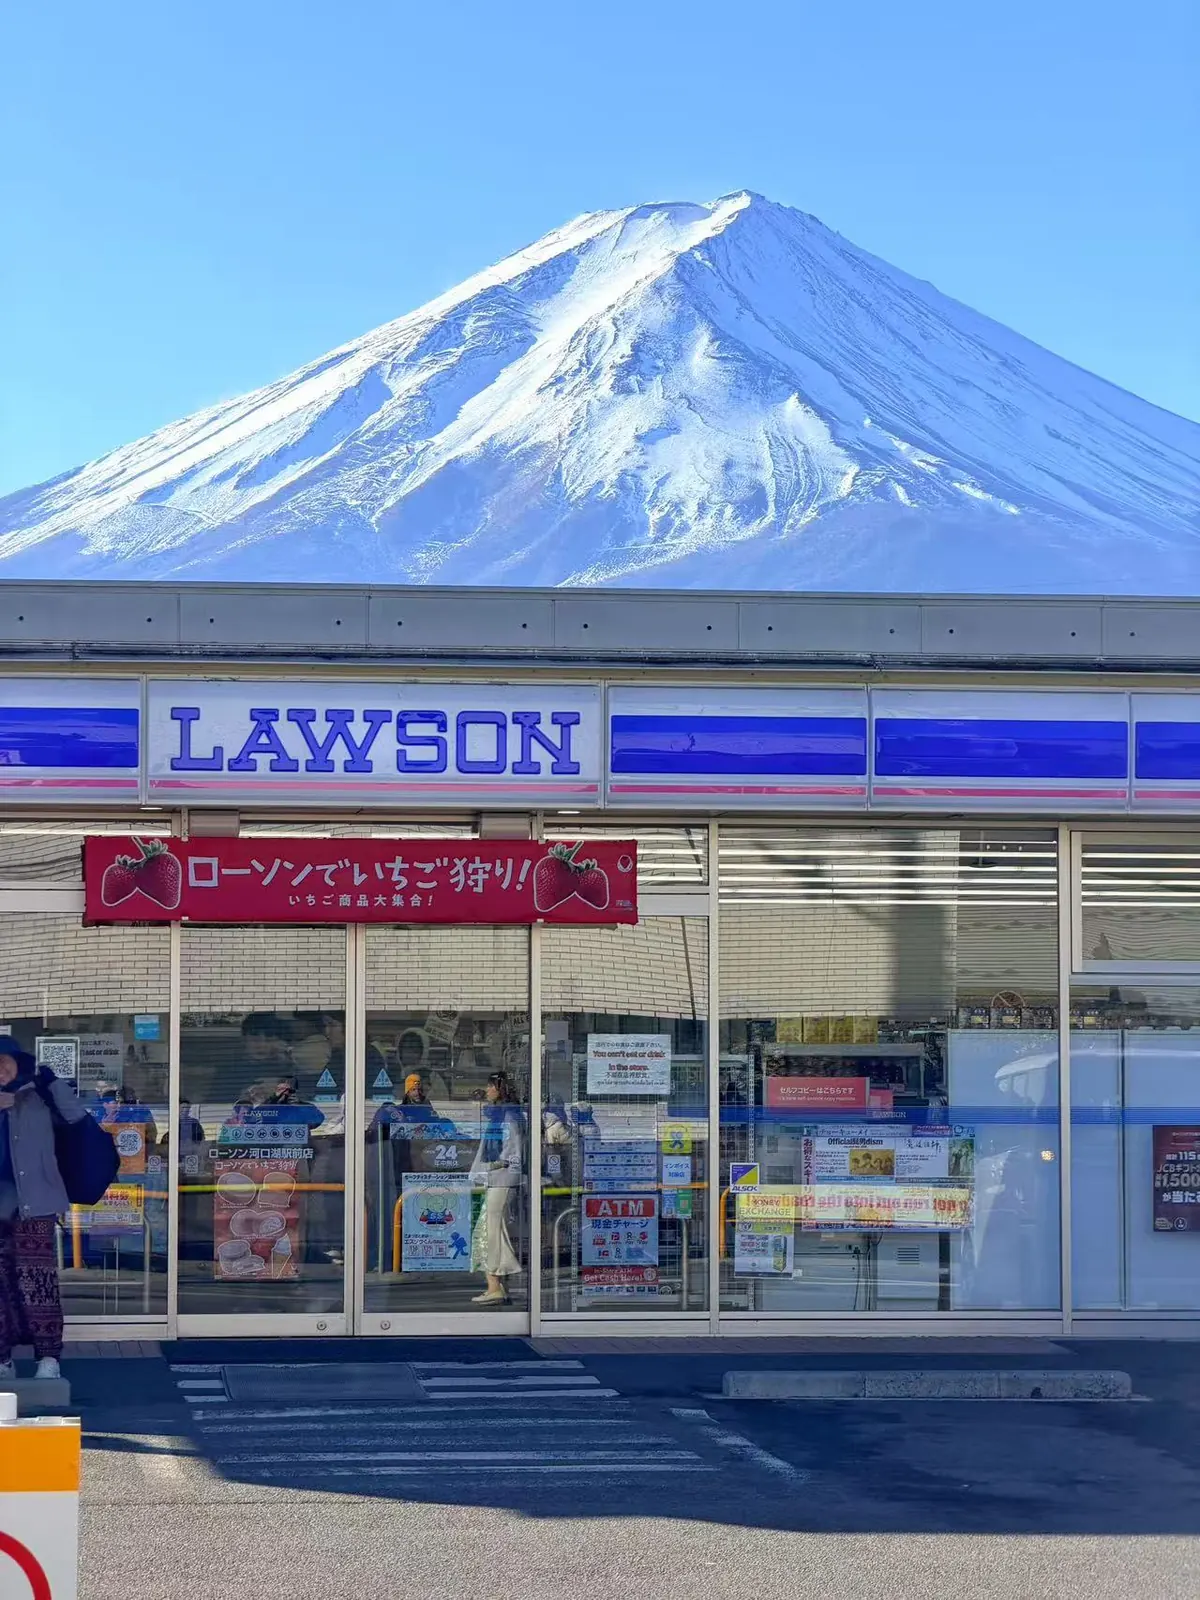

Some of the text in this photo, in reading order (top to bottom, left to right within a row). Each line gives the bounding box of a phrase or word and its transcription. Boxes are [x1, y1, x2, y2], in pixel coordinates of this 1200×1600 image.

[170, 707, 580, 774] LAWSON
[188, 855, 532, 893] ローソンでいちご狩り!
[289, 894, 434, 907] いちご商品大集合!
[616, 1063, 628, 1071] the
[208, 1148, 314, 1159] ローソン河口湖駅前店
[435, 1144, 458, 1160] 24
[597, 1200, 644, 1216] ATM
[740, 1207, 791, 1215] EXCHANGE
[592, 1219, 648, 1229] 現金チャージ
